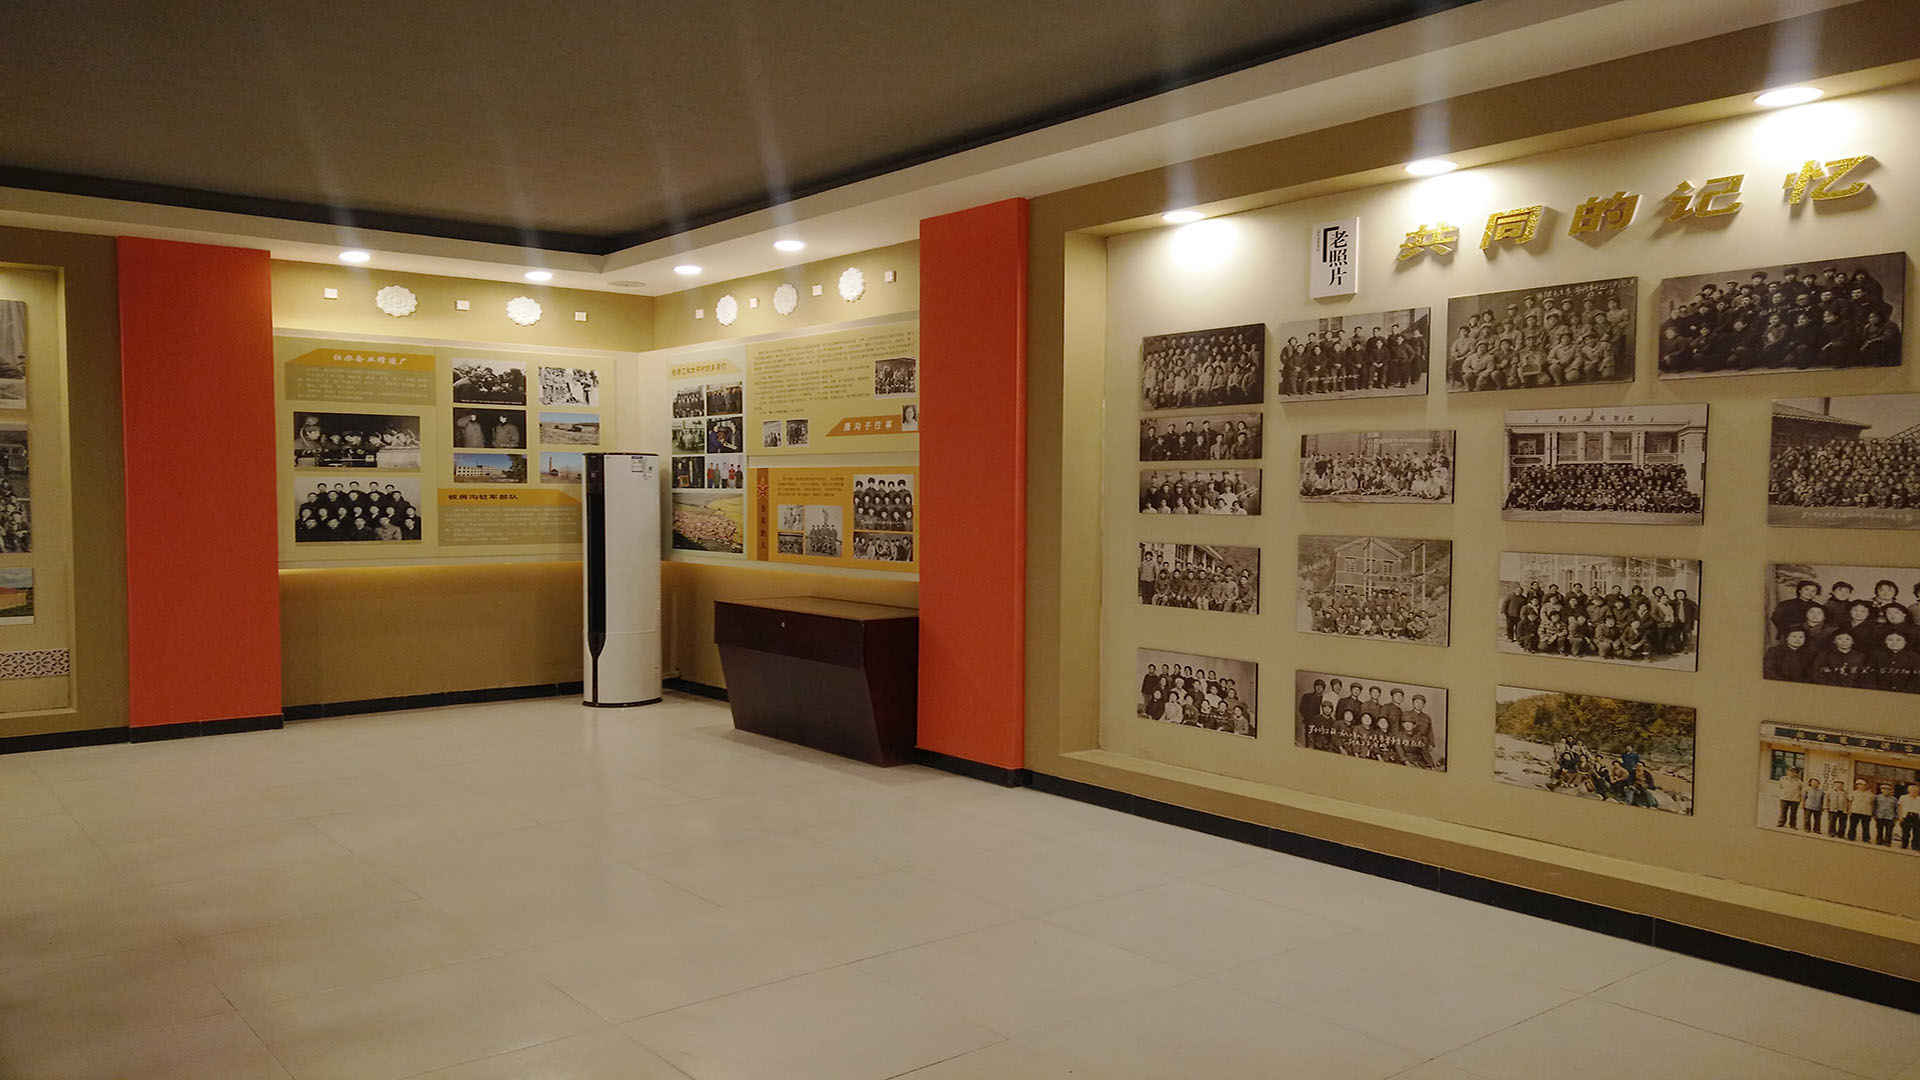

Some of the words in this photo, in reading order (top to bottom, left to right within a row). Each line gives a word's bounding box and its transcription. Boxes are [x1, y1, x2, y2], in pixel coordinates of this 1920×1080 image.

[1399, 154, 1877, 260] 共同的记忆
[1328, 230, 1349, 287] 老照片
